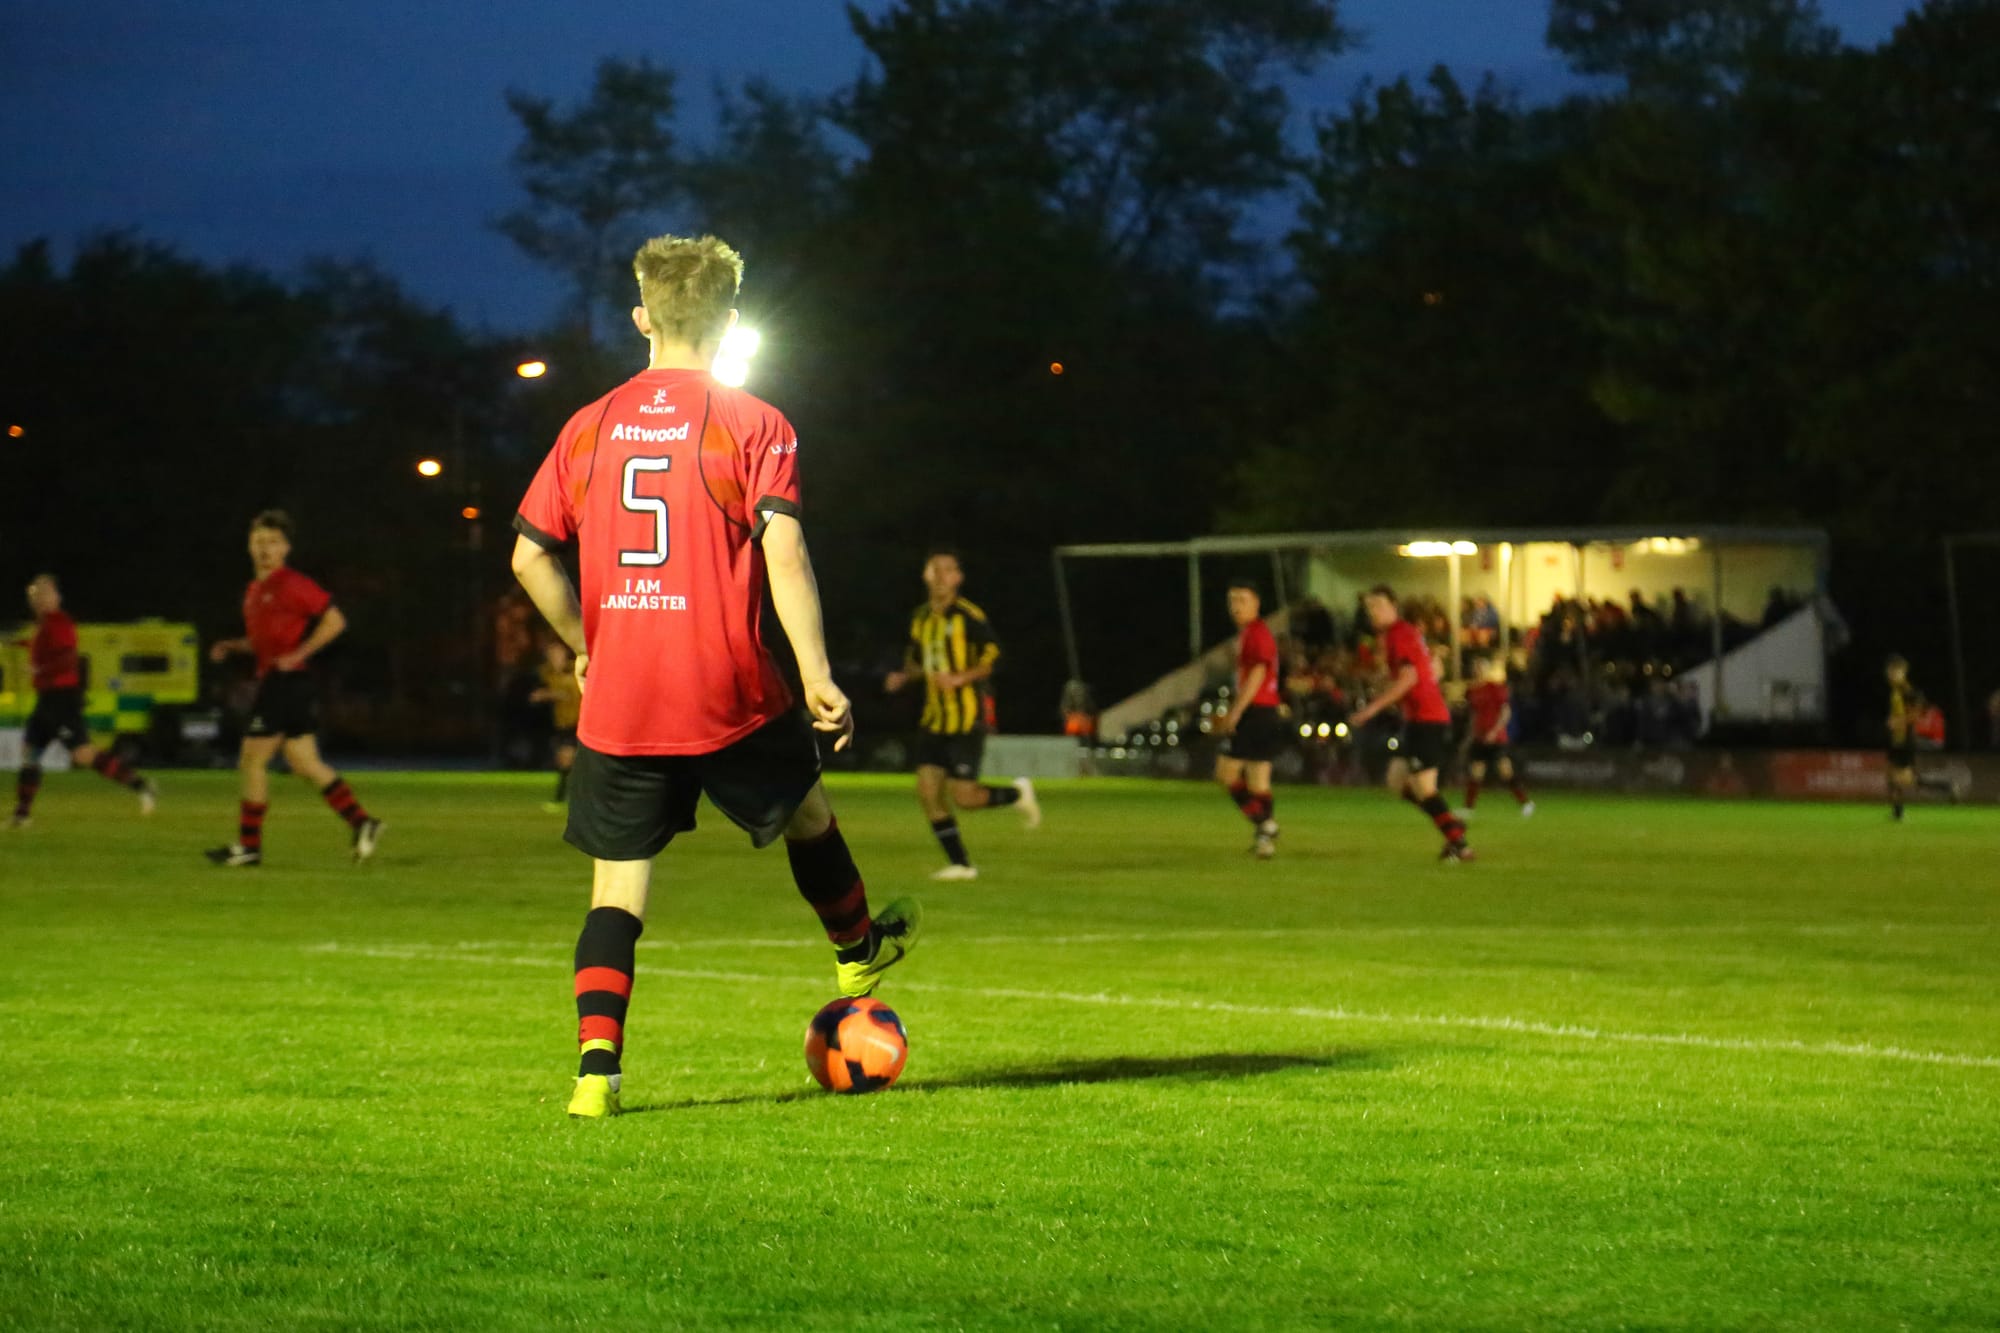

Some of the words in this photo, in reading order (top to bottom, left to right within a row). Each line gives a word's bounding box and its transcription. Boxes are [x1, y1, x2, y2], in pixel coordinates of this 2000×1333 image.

[639, 405, 675, 414] KUKRI
[611, 422, 690, 442] Attwood
[618, 455, 672, 567] 5
[625, 579, 631, 593] I
[635, 579, 661, 594] AM
